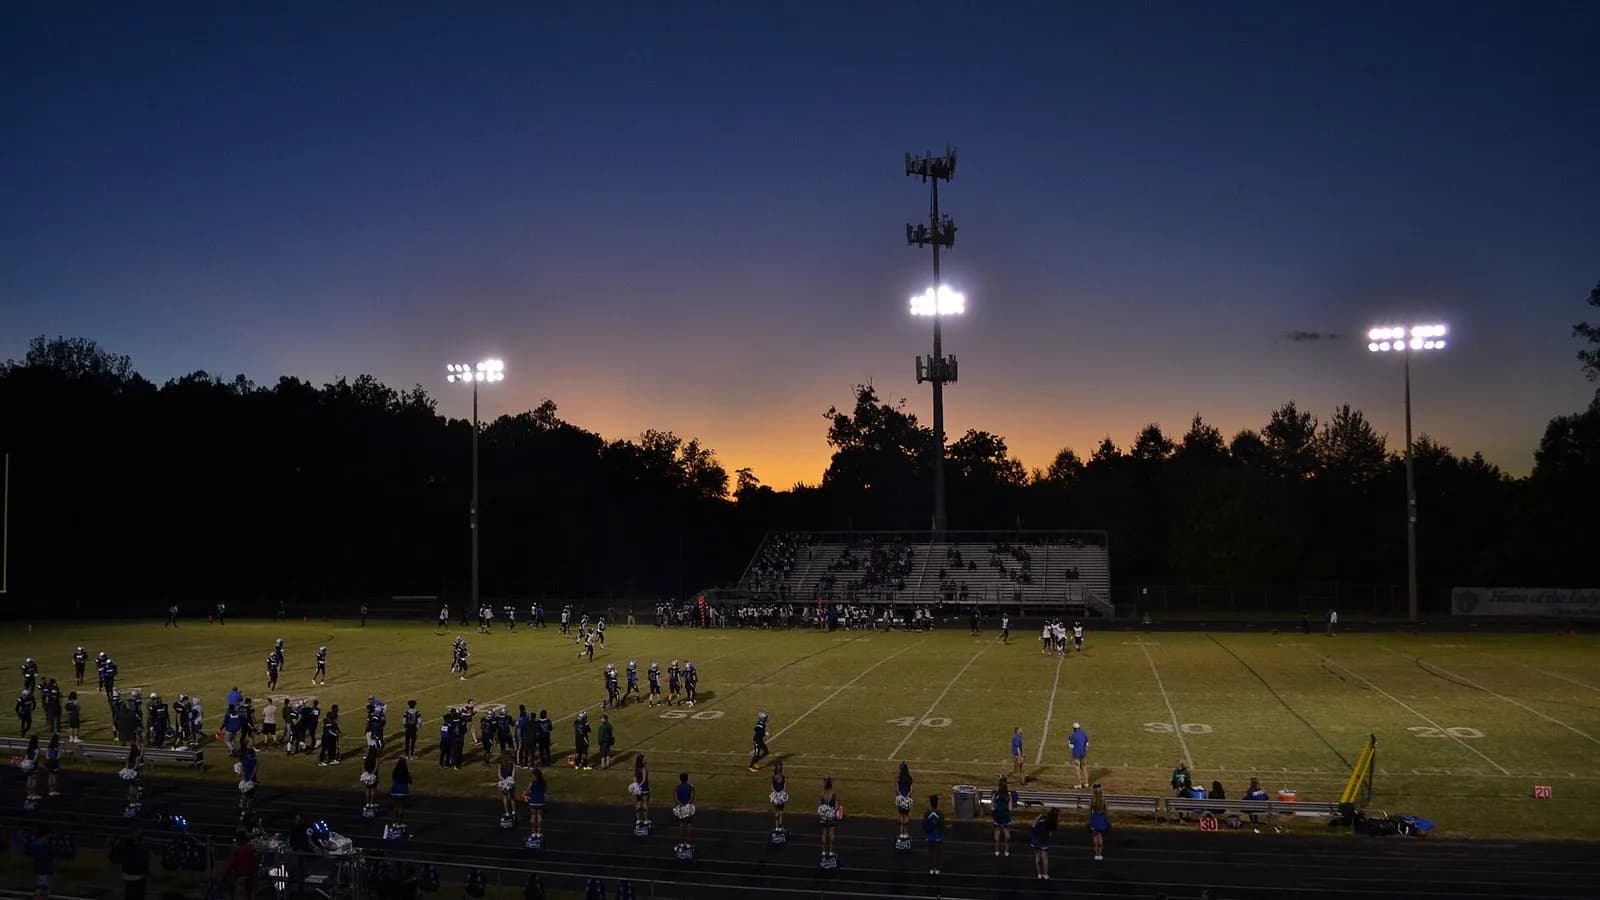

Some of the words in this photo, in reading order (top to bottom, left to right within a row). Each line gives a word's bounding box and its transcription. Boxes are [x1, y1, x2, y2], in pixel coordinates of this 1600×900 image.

[658, 709, 725, 720] 50
[885, 716, 953, 727] 40
[1143, 722, 1214, 734] 30
[1407, 726, 1486, 738] 20
[1535, 787, 1550, 800] 20
[1200, 817, 1217, 831] 30
